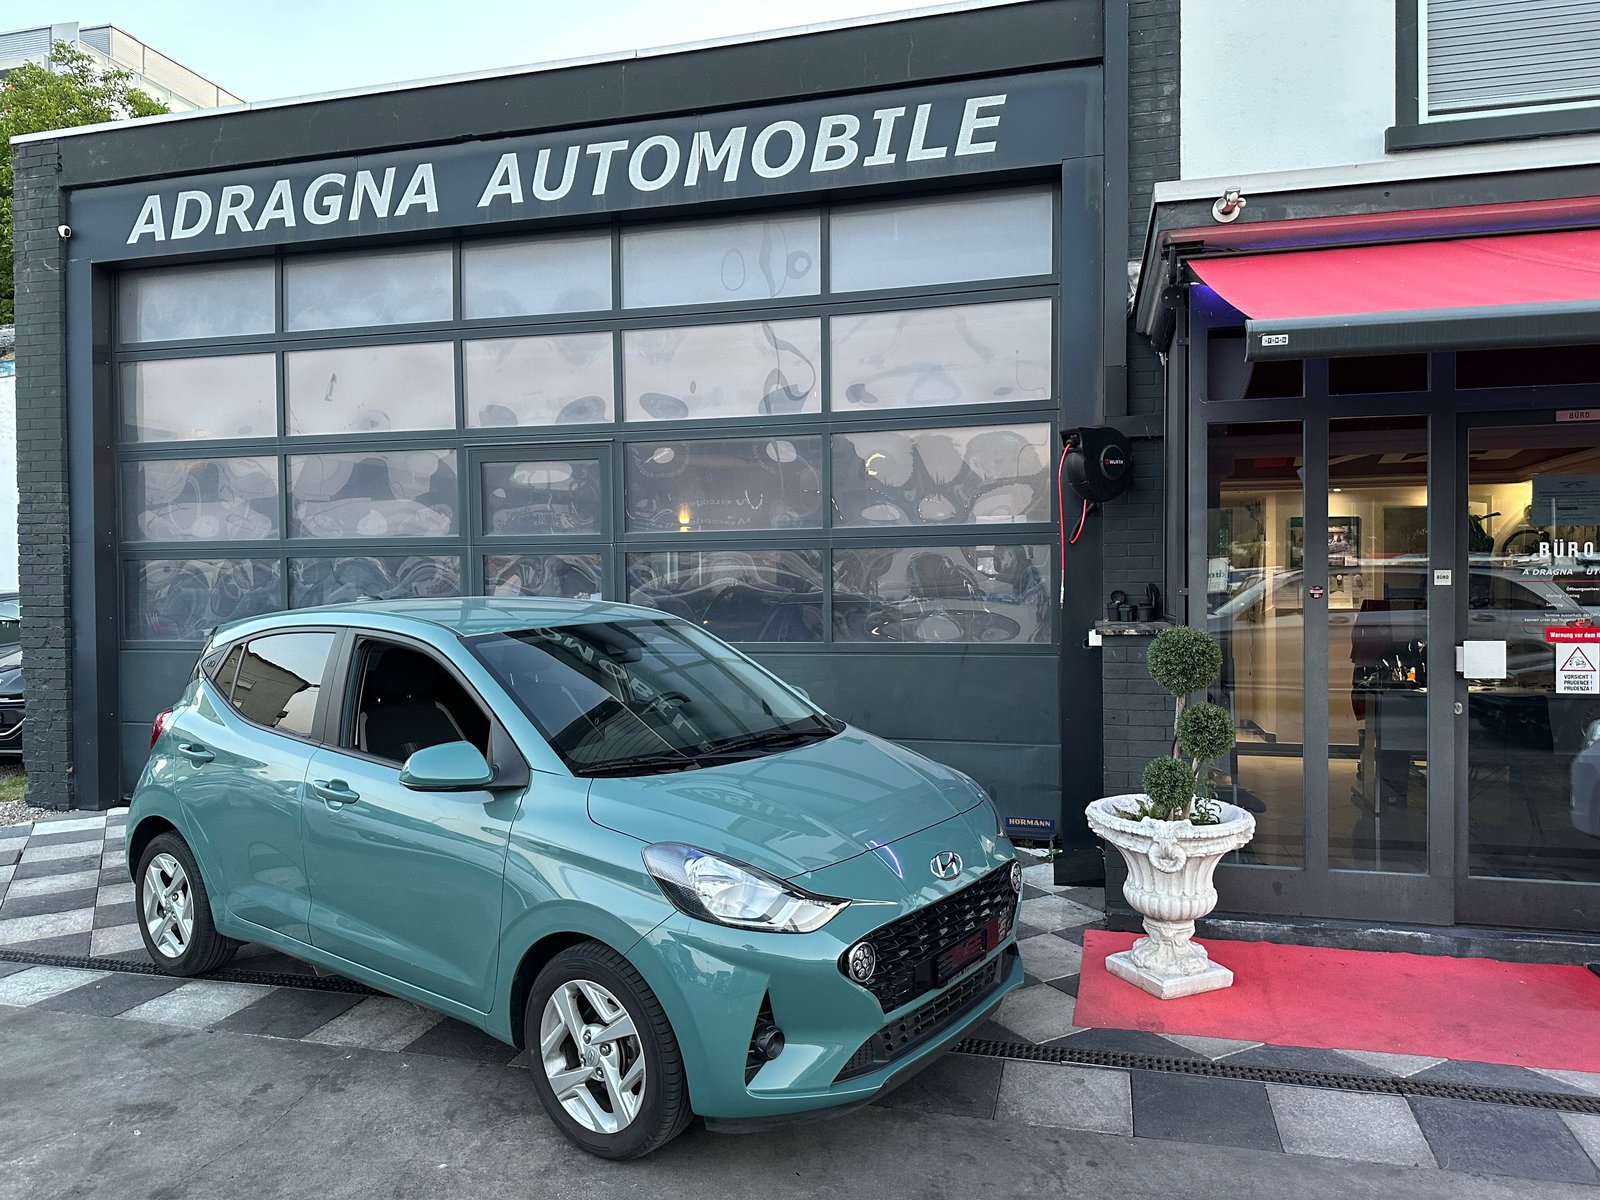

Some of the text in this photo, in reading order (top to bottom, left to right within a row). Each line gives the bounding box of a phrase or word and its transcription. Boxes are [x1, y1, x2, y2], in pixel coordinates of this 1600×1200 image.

[126, 93, 1008, 245] ADRAGNA AUTOMOBILE
[1569, 410, 1590, 419] BÜRO
[1539, 538, 1594, 558] BÜRO
[1550, 631, 1573, 639] Warnung
